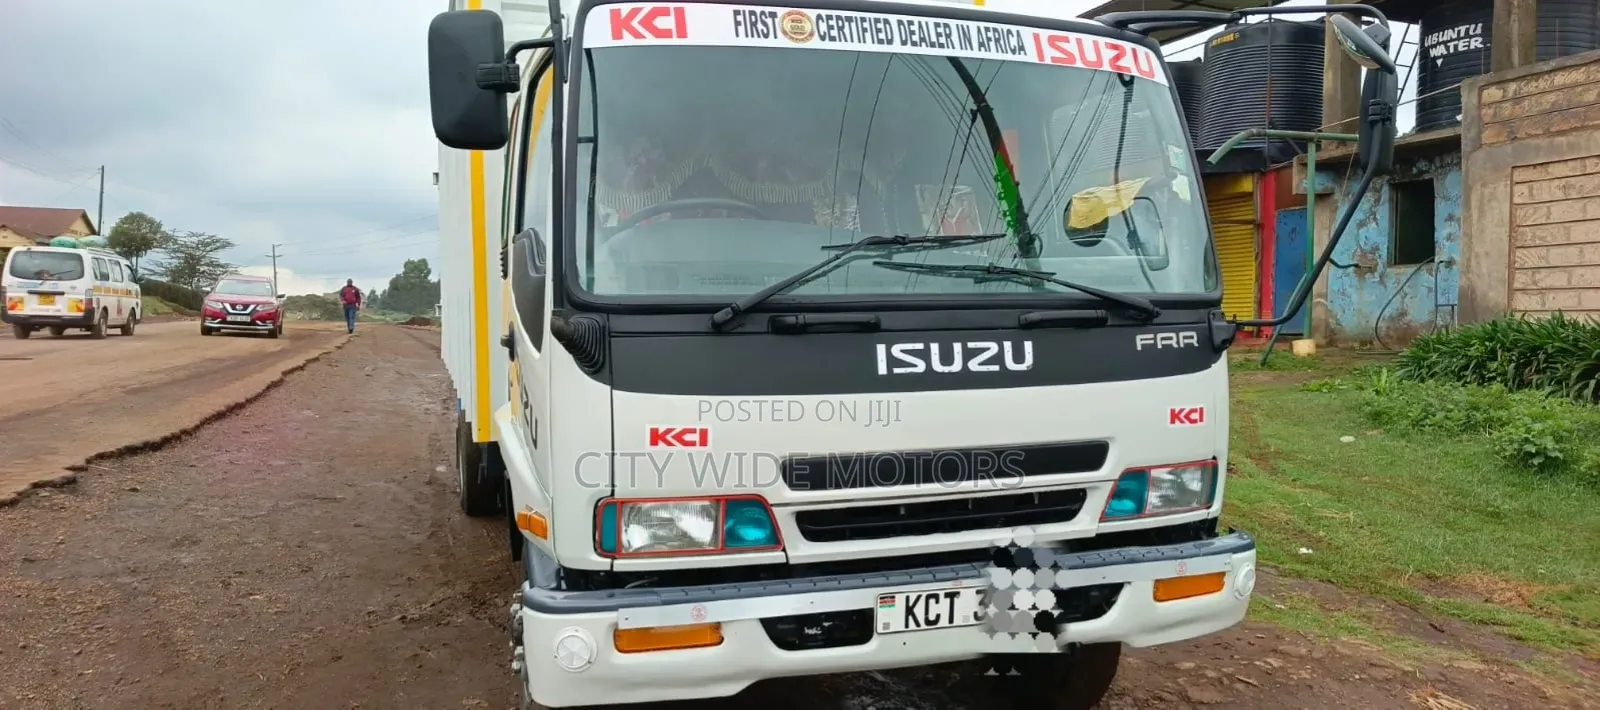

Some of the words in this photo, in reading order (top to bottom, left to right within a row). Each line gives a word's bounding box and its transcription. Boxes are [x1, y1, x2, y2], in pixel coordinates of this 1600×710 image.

[609, 7, 688, 41] KCI
[733, 9, 778, 39] FIRST
[815, 13, 894, 46] CERTIFIED
[897, 18, 952, 51] DEALER
[956, 23, 974, 51] IN
[976, 26, 1027, 56] AFRICA
[1424, 22, 1483, 47] UBUNTU
[1032, 32, 1156, 79] ISUZU
[876, 340, 1034, 375] ISUZU
[1136, 331, 1199, 351] FRR
[1169, 407, 1205, 425] KCI
[650, 428, 709, 447] KCI
[904, 591, 961, 629] KCT
